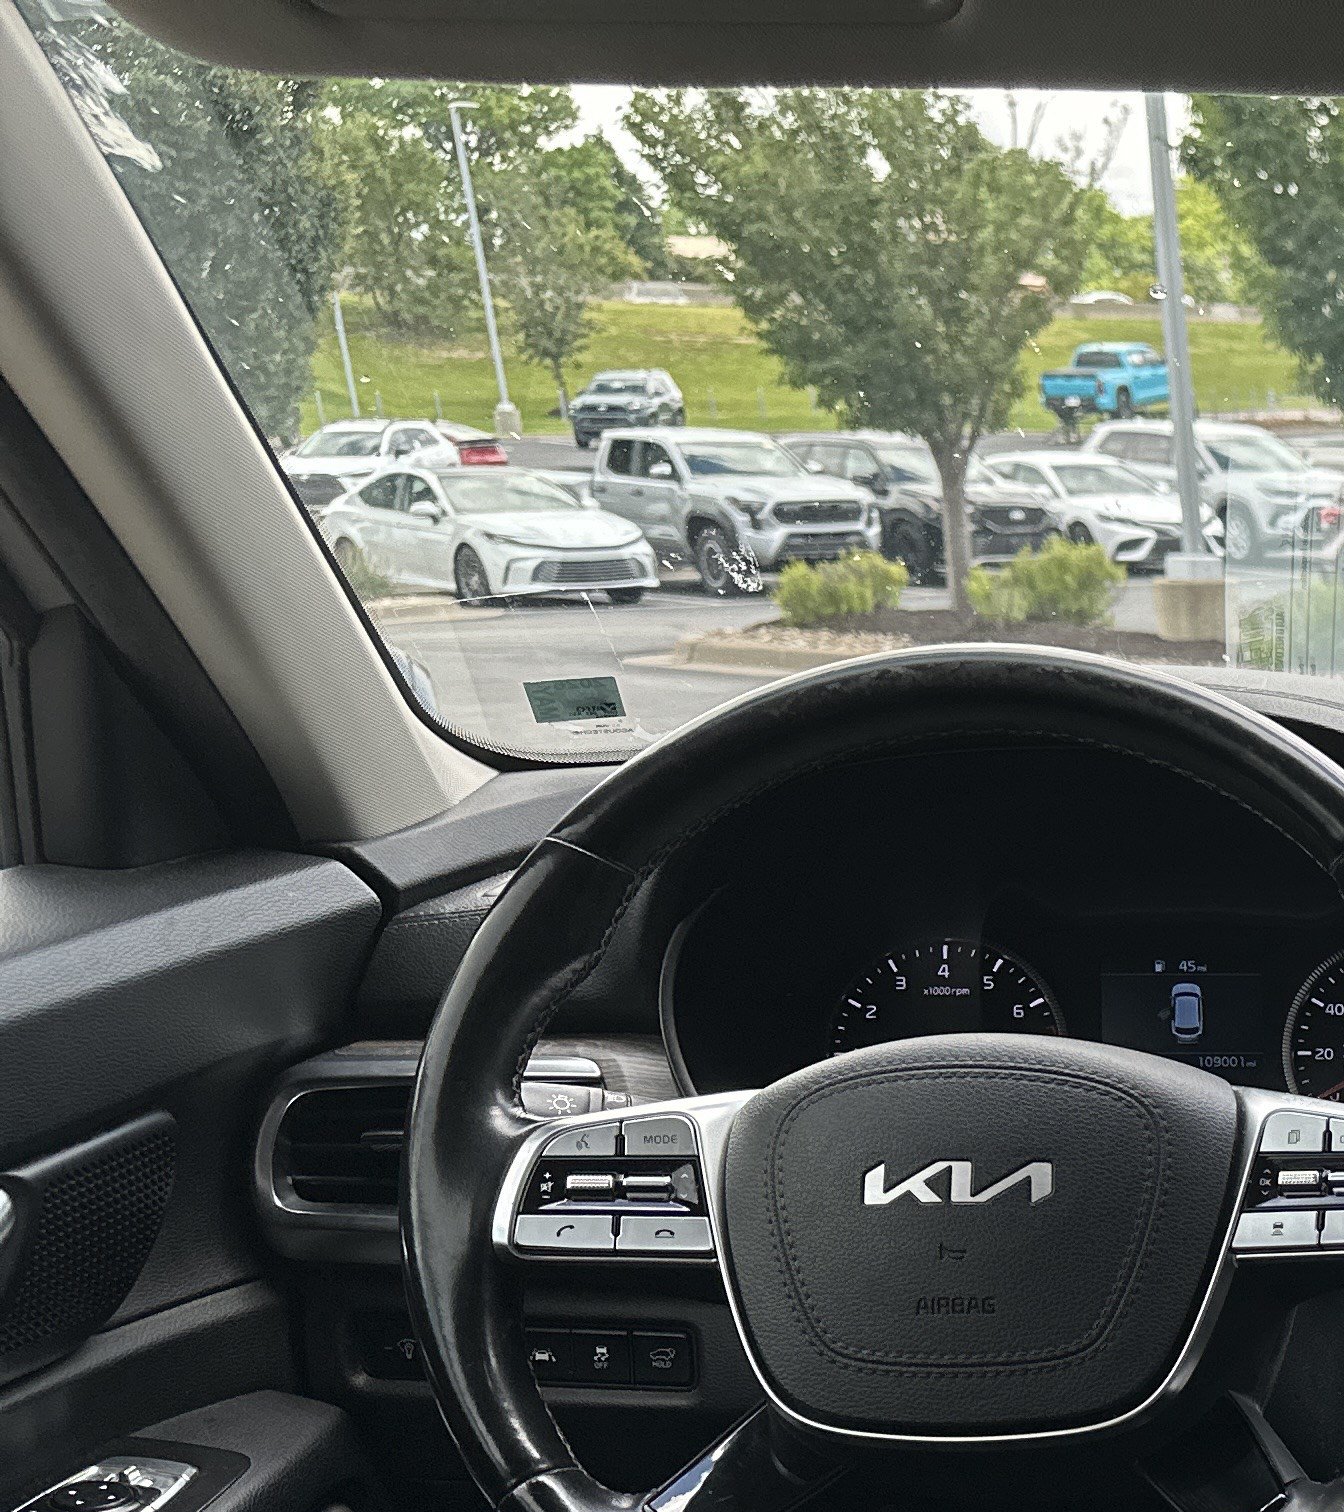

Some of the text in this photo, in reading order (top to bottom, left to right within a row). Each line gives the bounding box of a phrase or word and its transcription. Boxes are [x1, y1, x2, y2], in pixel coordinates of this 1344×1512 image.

[938, 963, 951, 979] 4
[895, 976, 907, 990] 3
[983, 976, 994, 990] 5
[865, 1005, 877, 1019] 2
[1013, 1004, 1025, 1018] 6
[1325, 1003, 1344, 1016] 40
[1314, 1048, 1334, 1061] 20
[643, 1134, 678, 1145] MODE
[1259, 1178, 1272, 1187] OK
[916, 1296, 997, 1316] AIRBAG
